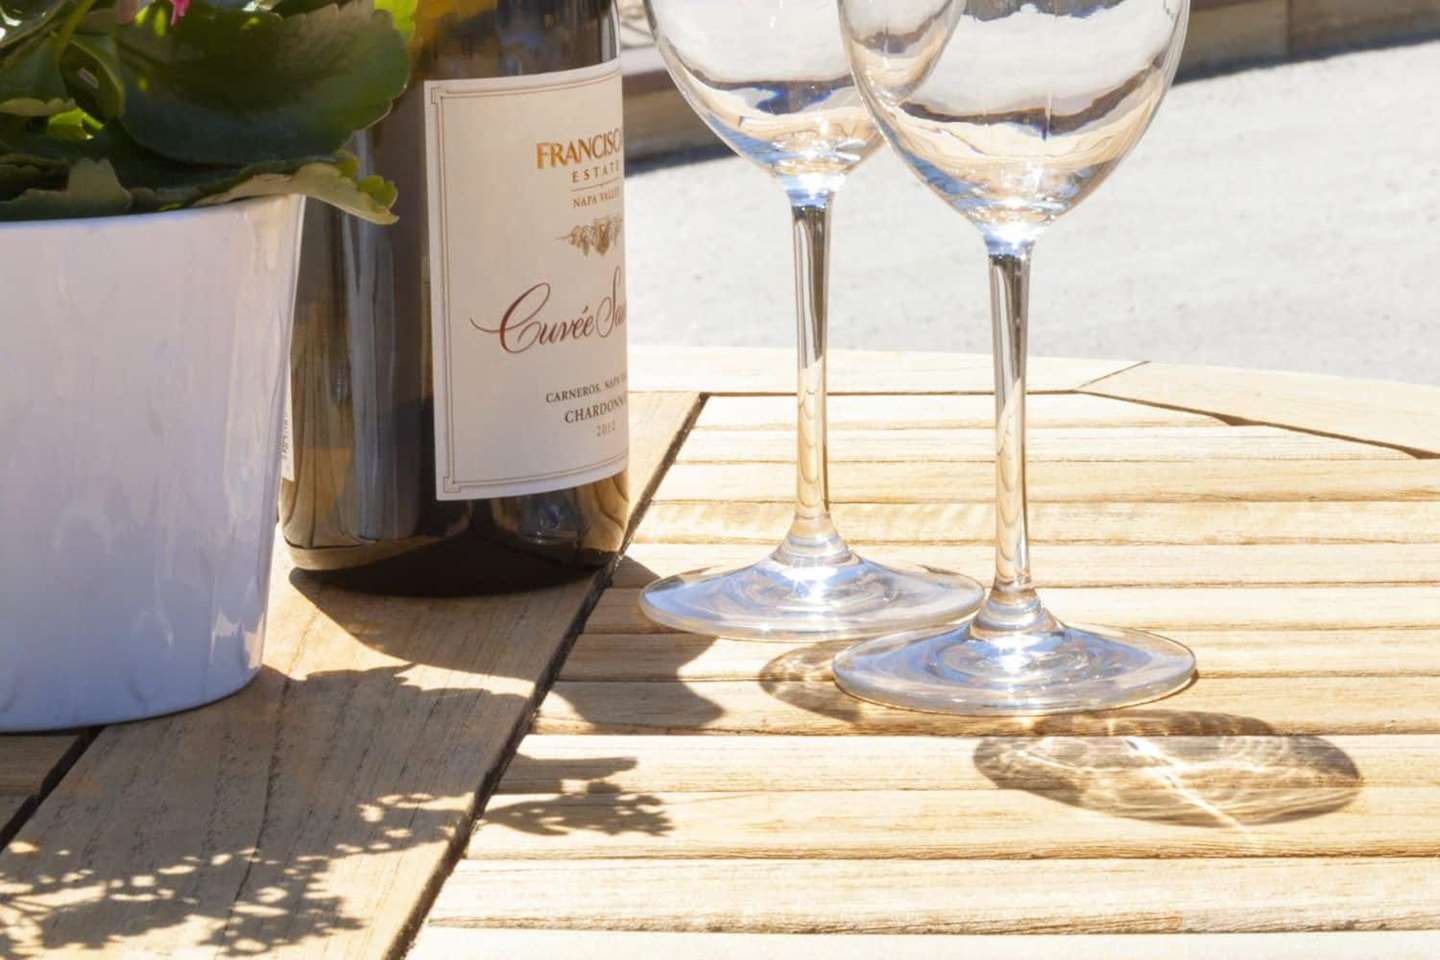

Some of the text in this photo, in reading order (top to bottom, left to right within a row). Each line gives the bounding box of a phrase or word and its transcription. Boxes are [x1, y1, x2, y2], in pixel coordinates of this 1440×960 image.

[536, 128, 621, 170] FRANCISC
[573, 194, 598, 208] NAPA
[470, 282, 593, 354] Cuvée
